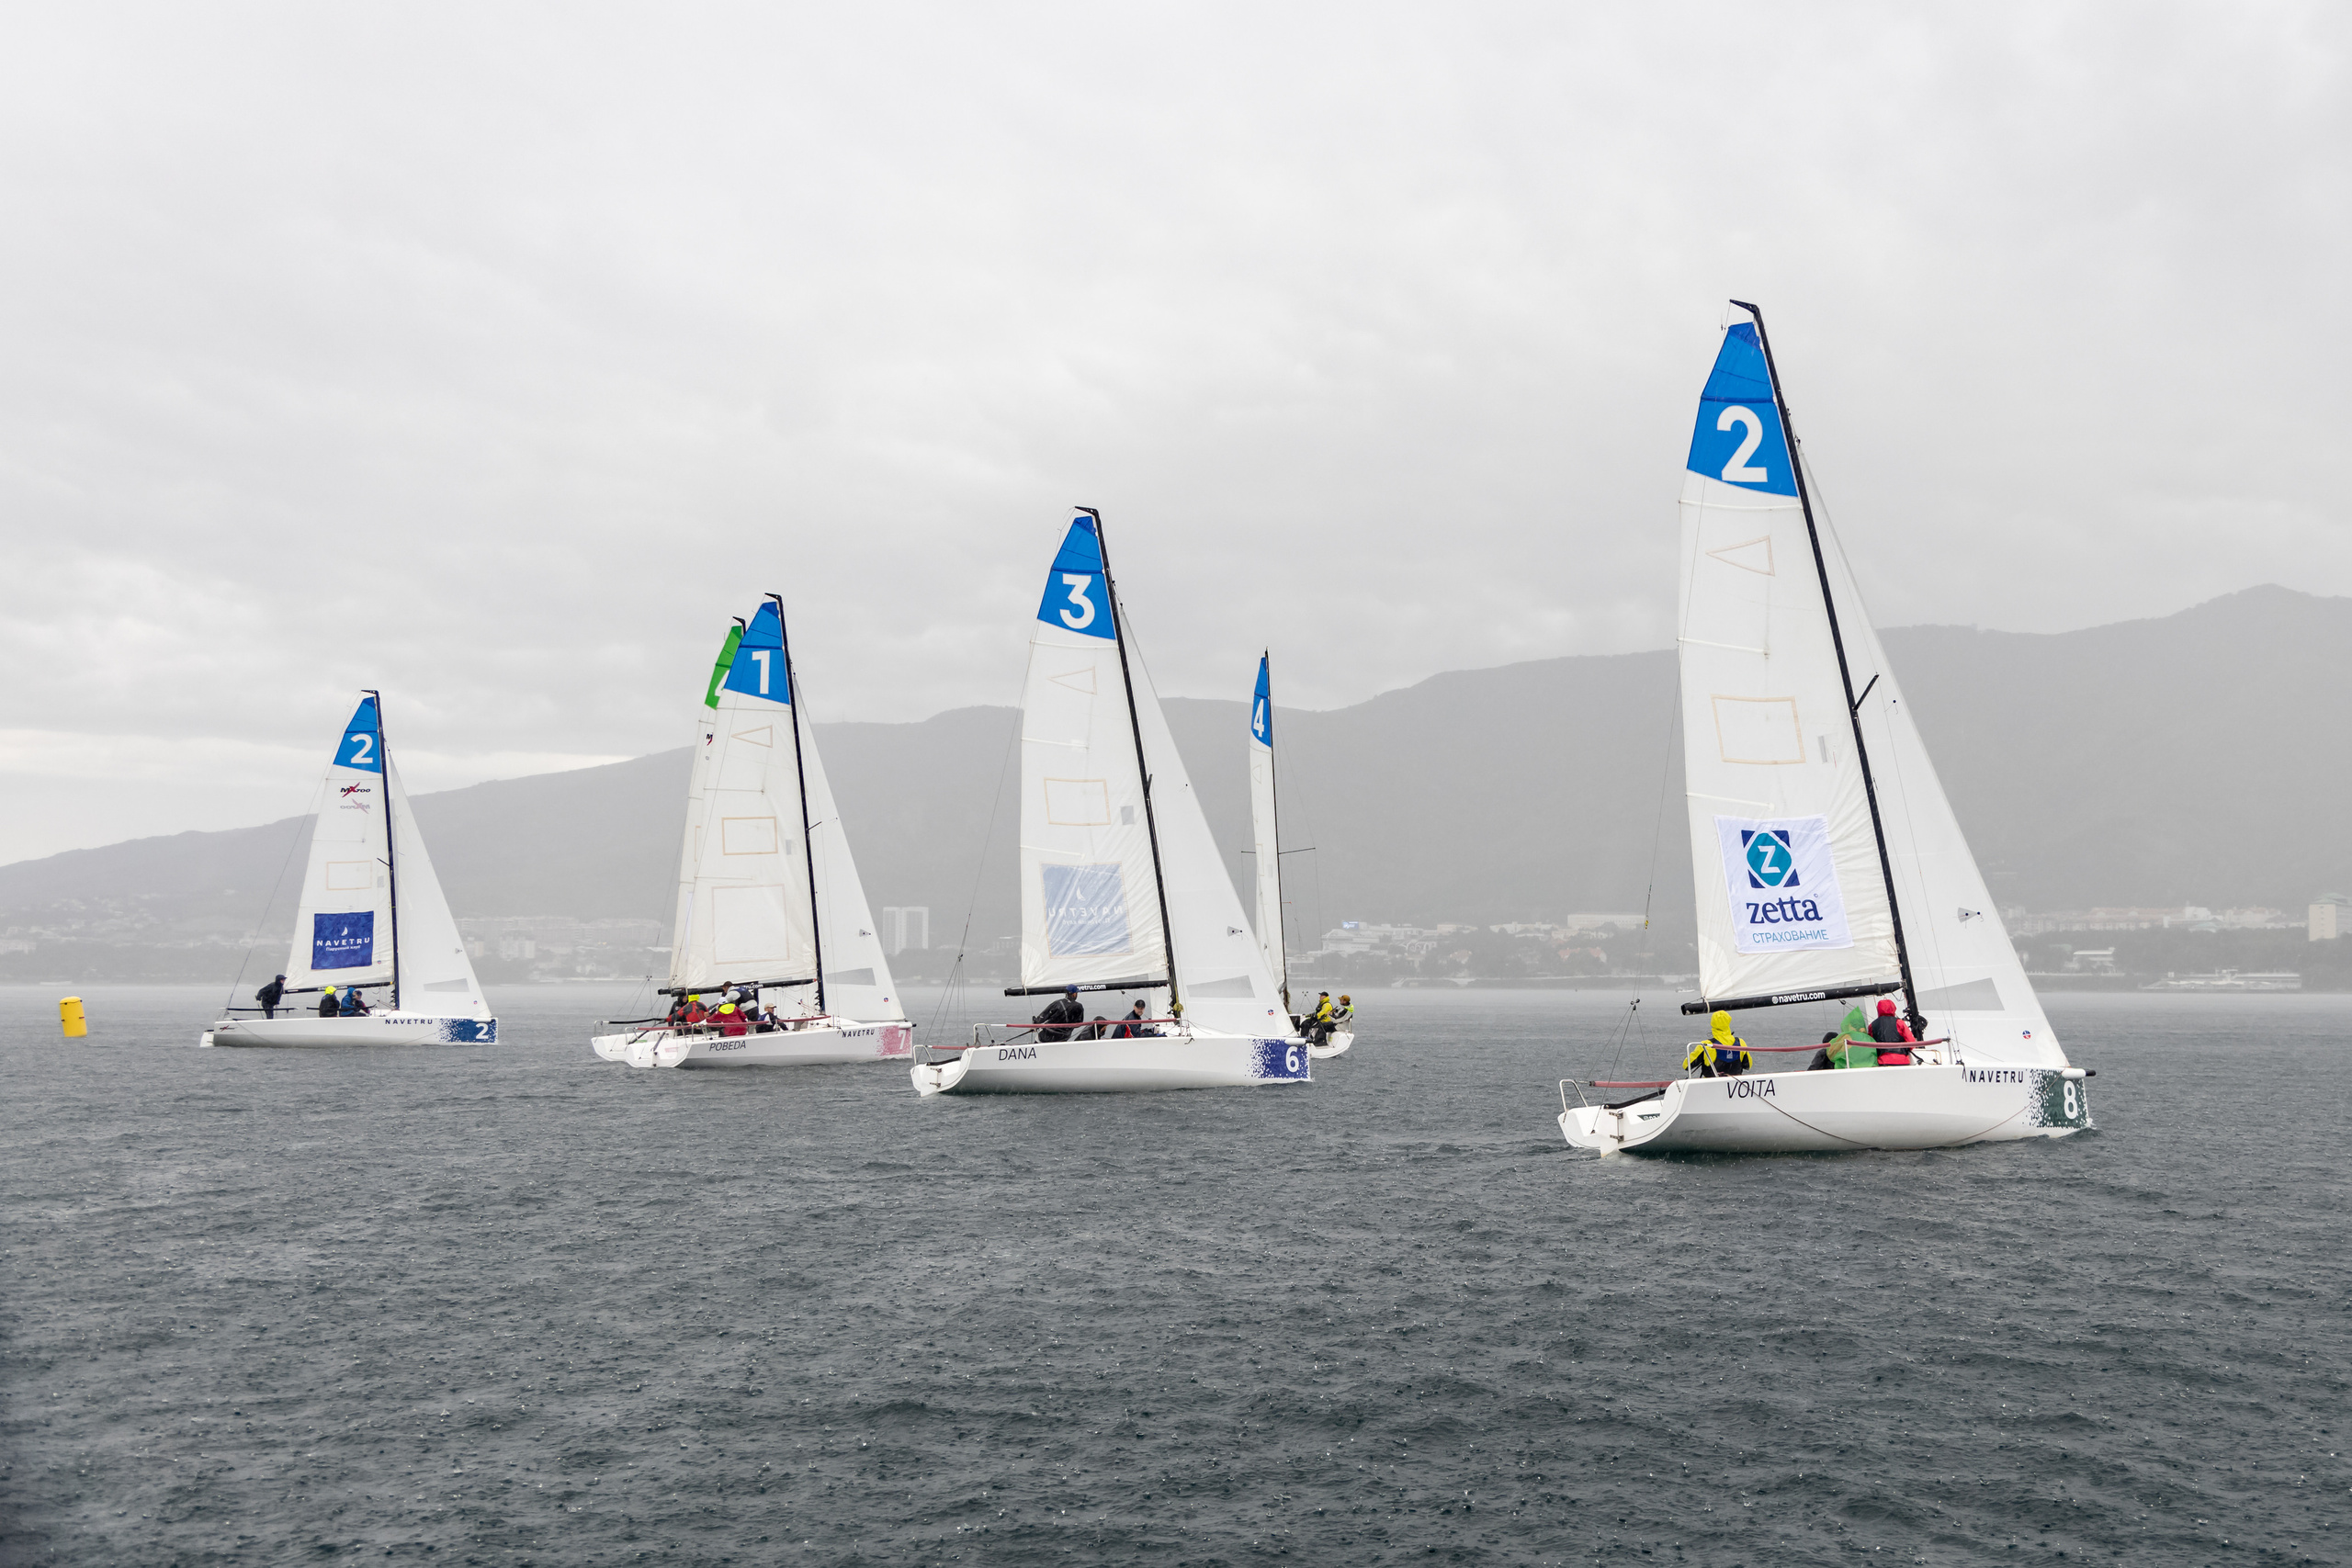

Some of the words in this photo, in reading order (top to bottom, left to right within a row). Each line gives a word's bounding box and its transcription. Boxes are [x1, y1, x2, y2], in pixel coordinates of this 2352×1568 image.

[1716, 405, 1768, 482] 2
[1059, 573, 1095, 629] 3
[752, 650, 770, 694] 1
[1253, 699, 1264, 738] 4
[350, 733, 374, 763] 2
[1746, 896, 1824, 924] zetta
[316, 937, 370, 947] NAVETRU
[1752, 929, 1829, 943] СТРАХОВАНИЕ
[1779, 992, 1826, 1003] navetru.com
[475, 1022, 489, 1040] 2
[842, 1029, 876, 1038] NAVETRU
[898, 1030, 907, 1050] 7
[709, 1040, 746, 1052] POBEDA
[999, 1047, 1037, 1061] DANA
[1285, 1046, 1299, 1073] 6
[1969, 1069, 2024, 1083] NAVETRU
[1727, 1079, 1776, 1099] VOITA
[2063, 1080, 2078, 1120] 8
